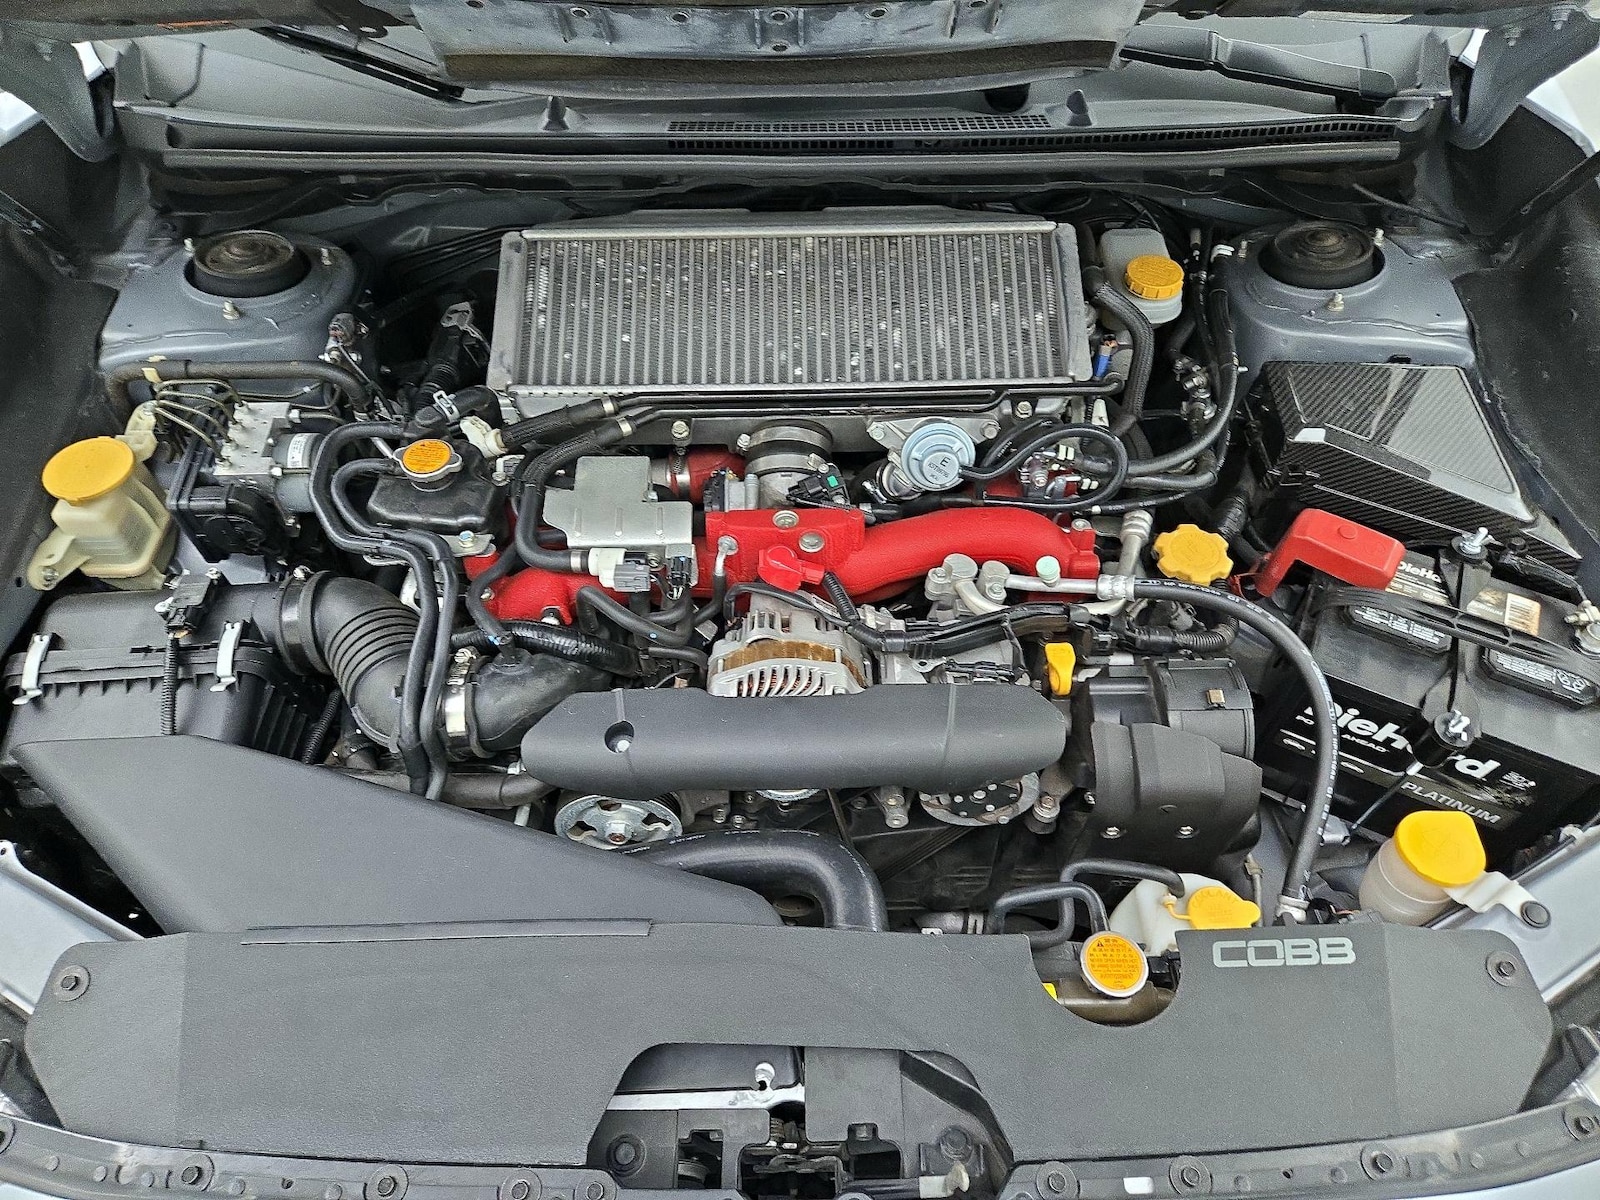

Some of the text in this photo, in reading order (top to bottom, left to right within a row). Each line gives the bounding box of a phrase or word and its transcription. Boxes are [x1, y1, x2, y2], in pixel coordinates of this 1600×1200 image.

[940, 457, 951, 467] E
[1397, 561, 1442, 583] DieHa
[1304, 702, 1502, 779] DieHd
[1340, 734, 1388, 752] AHEAD
[1401, 782, 1502, 824] PLATINUM
[1192, 889, 1240, 908] COOLANT
[1212, 936, 1357, 968] COBB
